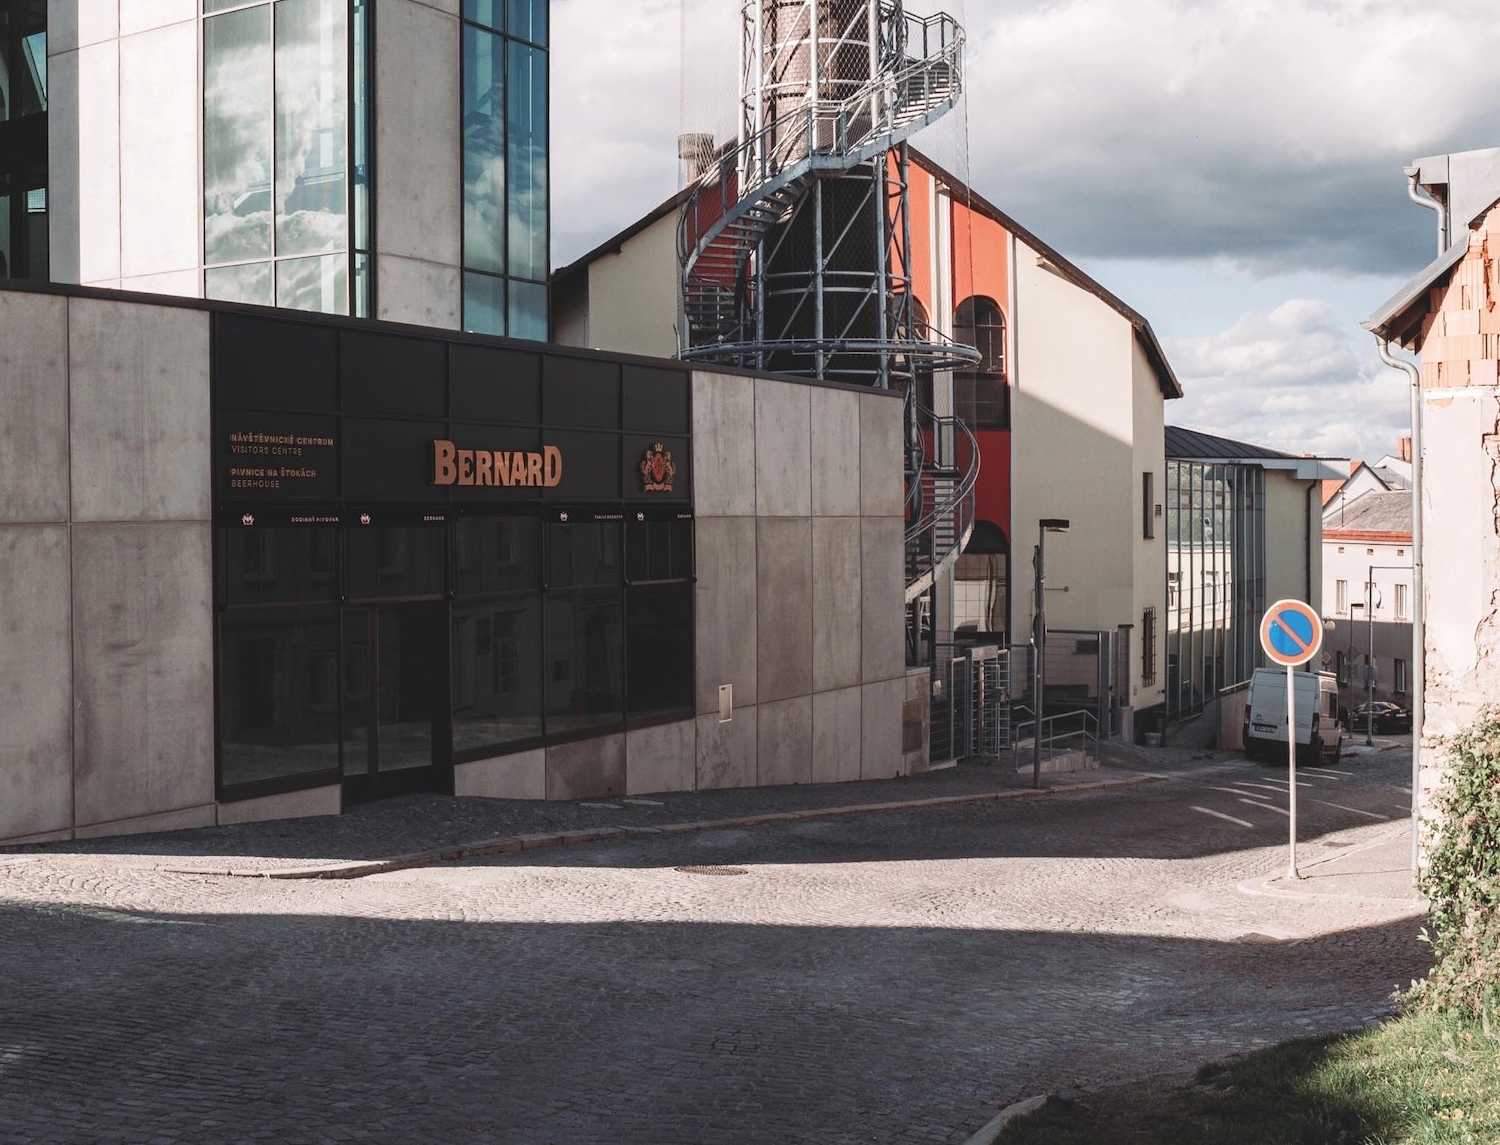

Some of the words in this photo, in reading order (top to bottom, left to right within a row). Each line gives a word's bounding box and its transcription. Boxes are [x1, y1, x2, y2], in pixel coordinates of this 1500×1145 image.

[230, 432, 294, 445] NÁVŠTĚVNICKÉ
[296, 437, 334, 446] CENTRUM
[231, 445, 269, 454] VISITORS
[271, 447, 302, 455] CENTRE
[432, 439, 562, 487] BERNARD
[230, 468, 264, 477] PIVNICE
[267, 469, 278, 477] NA
[231, 480, 280, 488] BEERHOUSE
